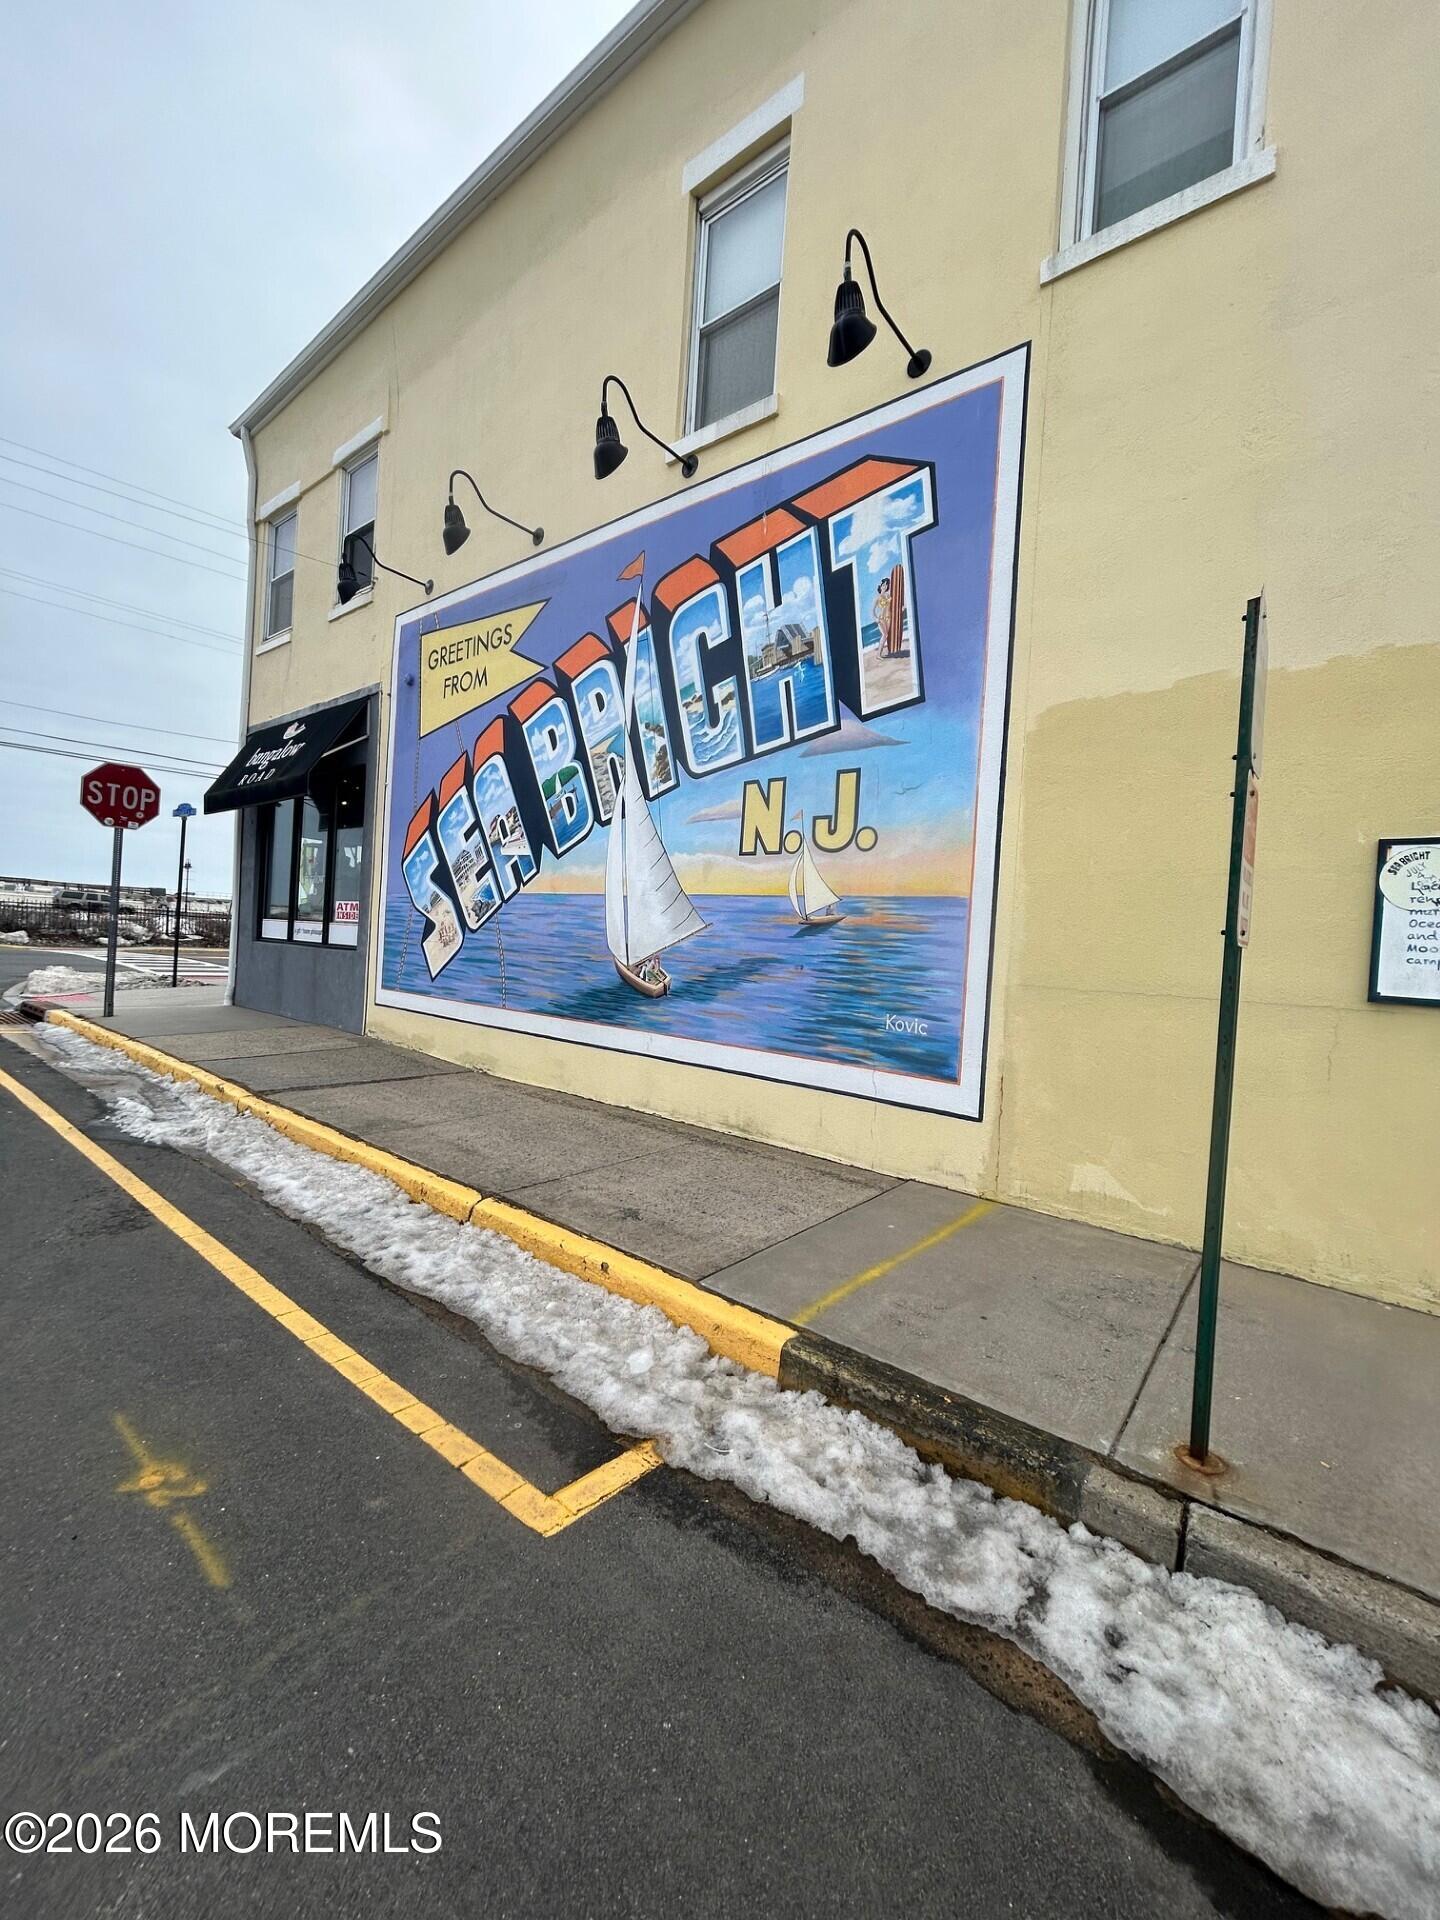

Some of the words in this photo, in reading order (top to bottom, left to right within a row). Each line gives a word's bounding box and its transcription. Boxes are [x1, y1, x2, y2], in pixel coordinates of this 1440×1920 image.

[428, 623, 512, 670] GREETINGS
[443, 666, 488, 699] FROM
[402, 712, 540, 982] SEA
[508, 454, 939, 861] BRIGHT
[237, 768, 276, 786] ROAD
[87, 780, 156, 811] STOP
[1399, 851, 1431, 866] BRIGHT
[336, 902, 359, 912] ATM
[336, 911, 359, 920] INSIDE
[1407, 931, 1439, 941] and
[885, 1013, 929, 1036] Kovic
